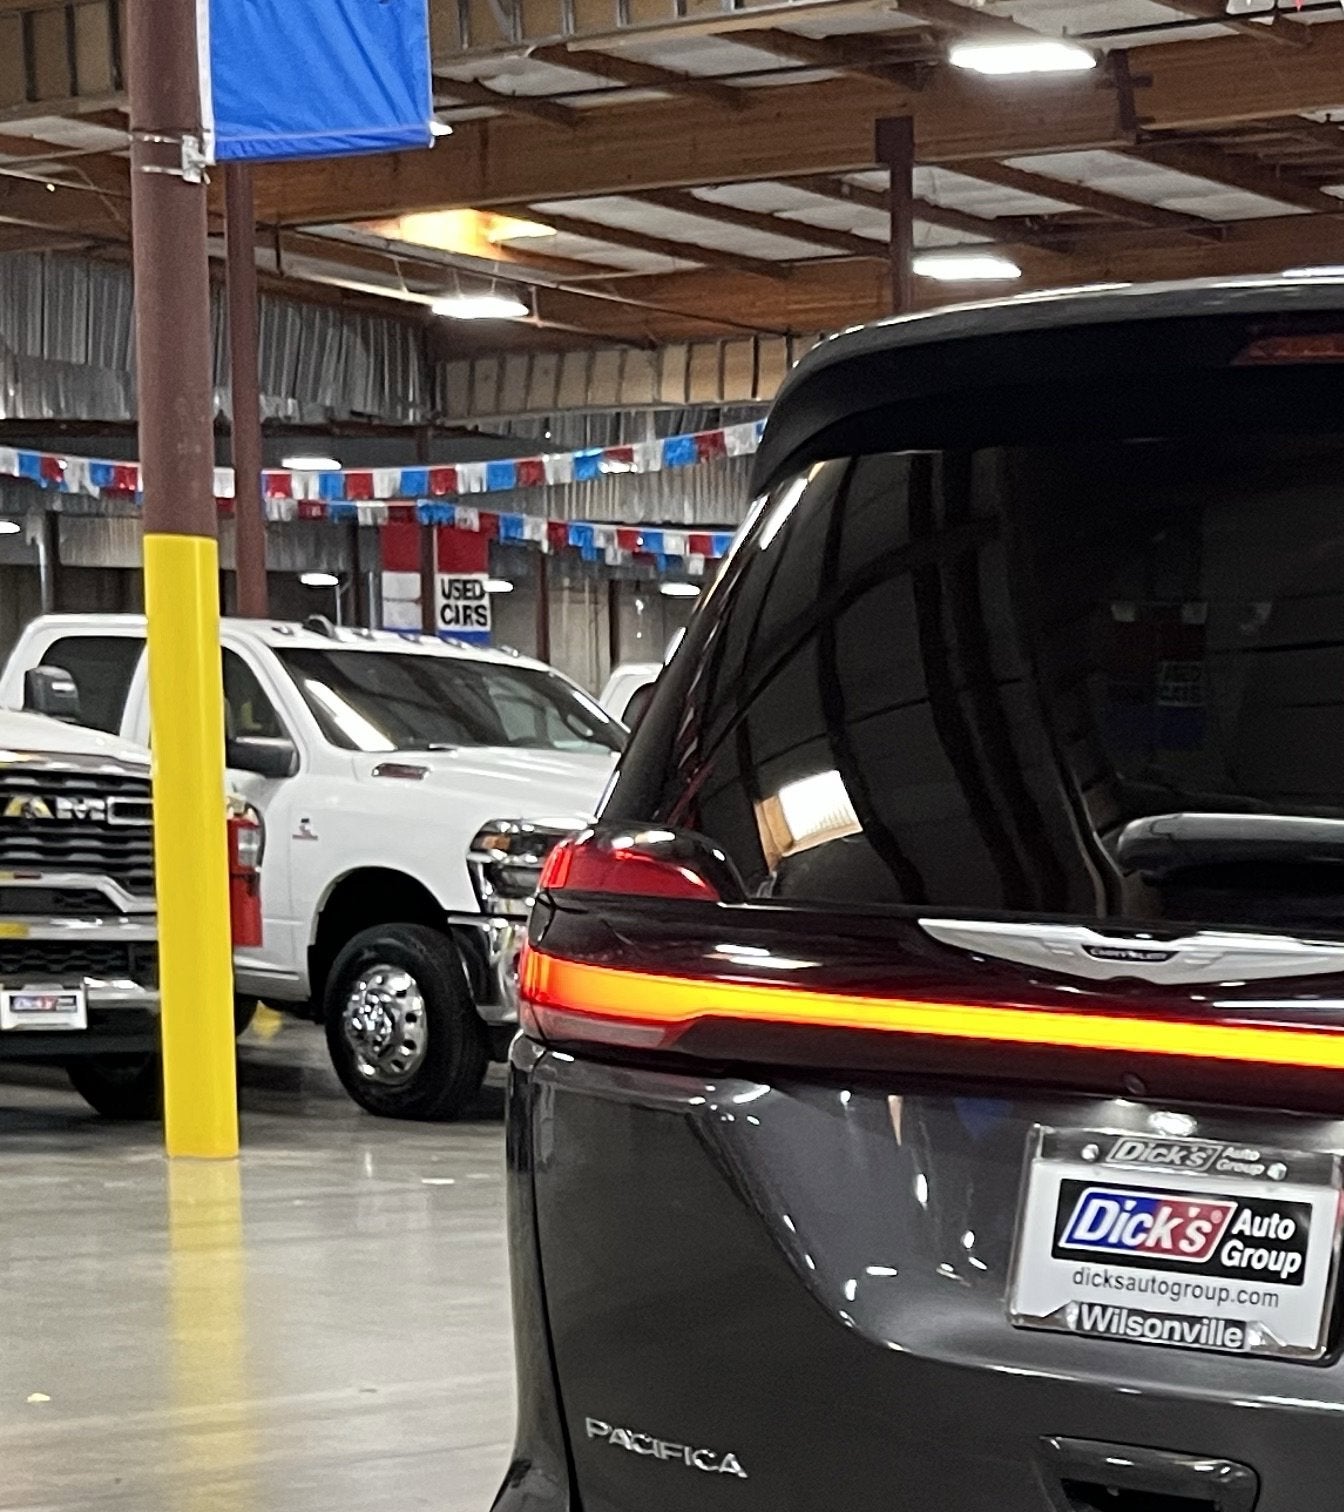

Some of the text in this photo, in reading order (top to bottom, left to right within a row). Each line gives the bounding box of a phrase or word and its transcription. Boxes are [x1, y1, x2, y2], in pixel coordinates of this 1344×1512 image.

[441, 578, 486, 600] USED
[2, 796, 106, 819] AM
[1115, 1140, 1208, 1167] Dick's
[1231, 1209, 1296, 1241] Auto
[1220, 1241, 1302, 1279] Group
[1073, 1266, 1280, 1308] dicksautogroup.com
[1080, 1303, 1244, 1348] Wilsonville
[585, 1416, 749, 1479] PACIFICA
